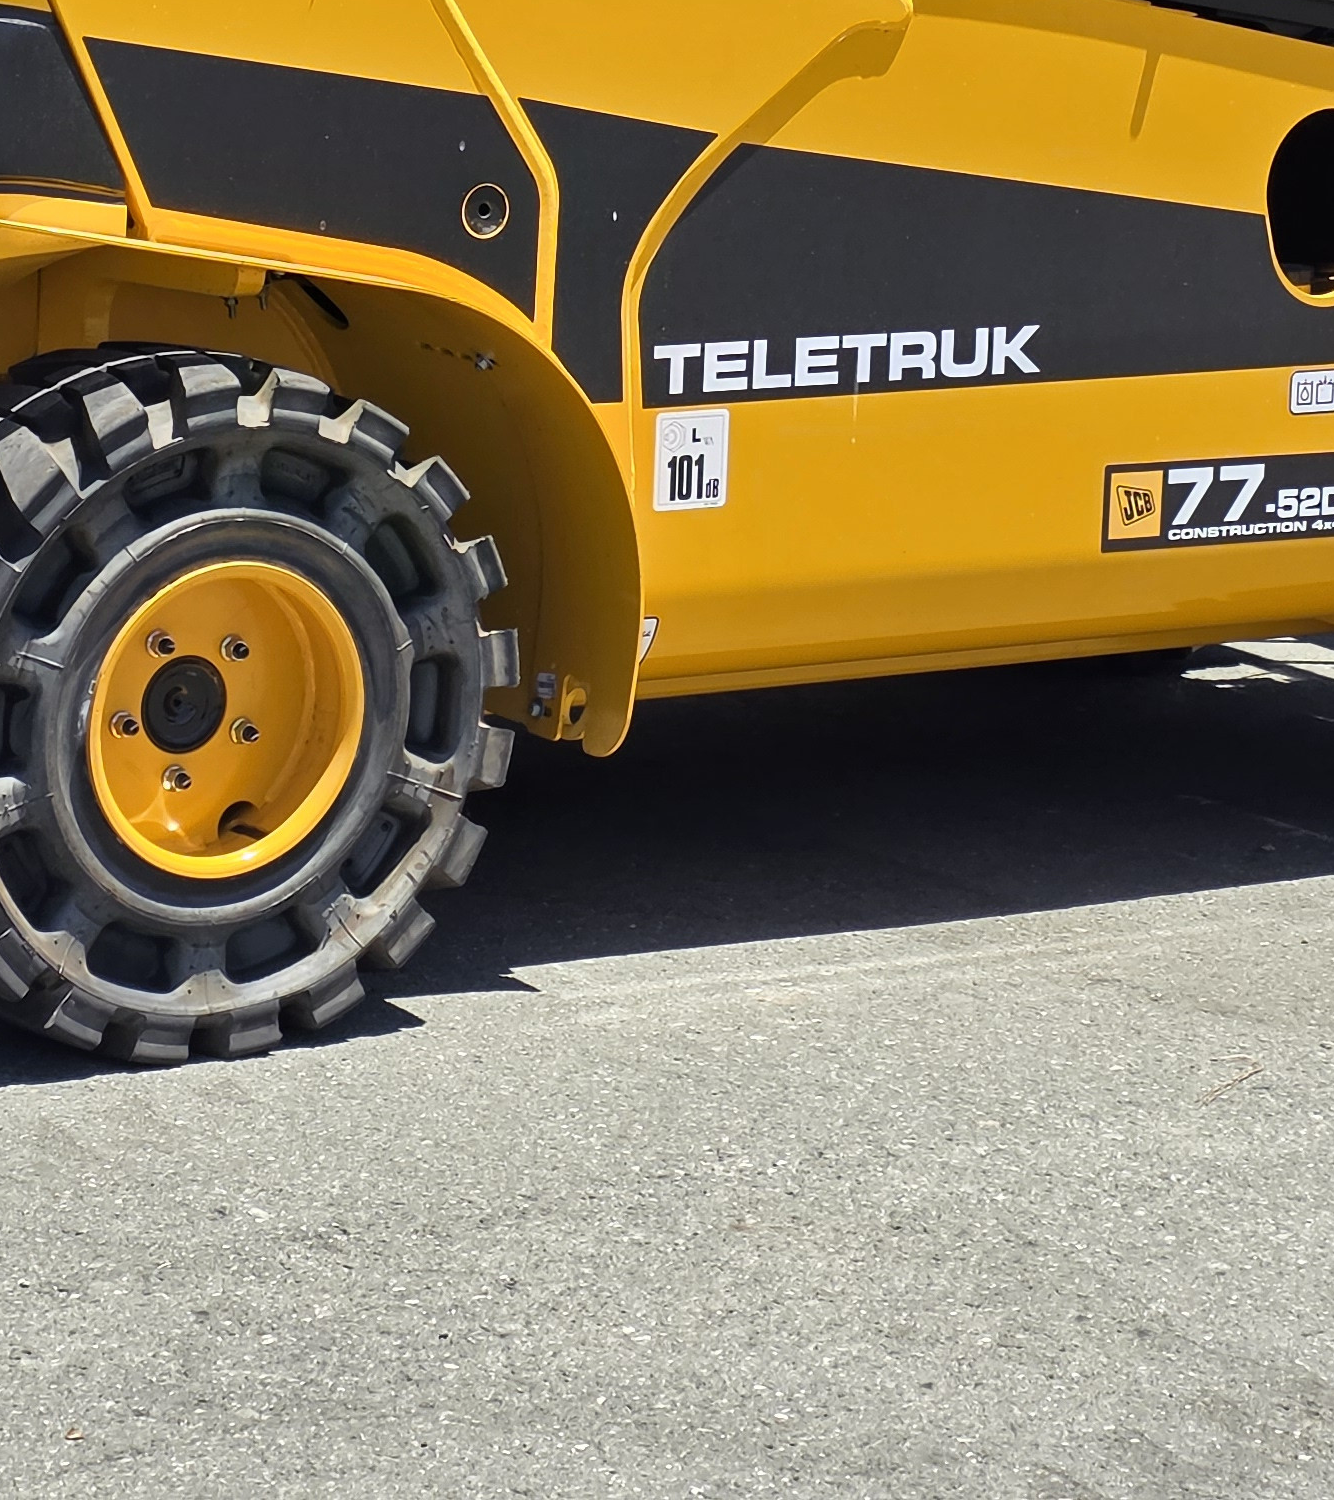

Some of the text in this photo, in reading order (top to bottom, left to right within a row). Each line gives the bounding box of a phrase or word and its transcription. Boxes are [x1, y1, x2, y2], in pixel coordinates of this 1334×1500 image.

[653, 325, 1040, 395] TELETRUK
[1122, 490, 1153, 521] JCB
[1168, 520, 1307, 540] CONSTRUCTION
